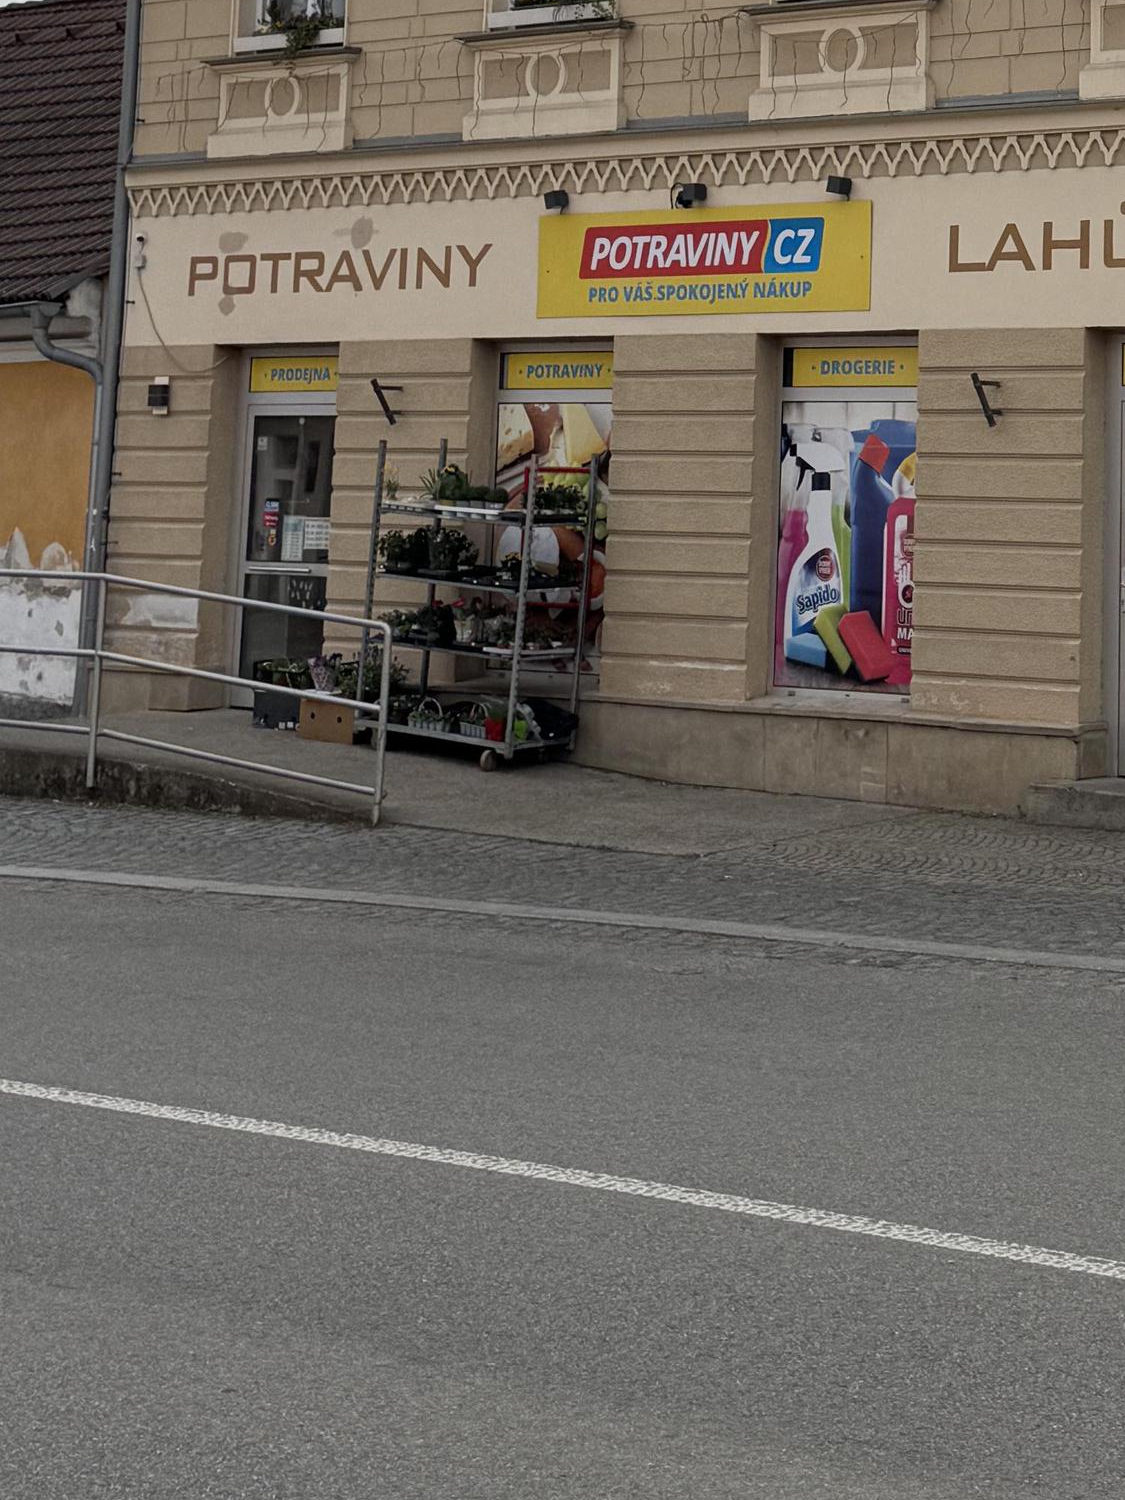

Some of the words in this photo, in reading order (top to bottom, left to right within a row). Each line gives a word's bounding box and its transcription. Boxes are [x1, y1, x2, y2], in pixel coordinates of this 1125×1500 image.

[590, 230, 760, 271] POTRAVINY
[773, 228, 815, 265] CZ
[187, 243, 493, 297] POTRAVINY
[588, 286, 618, 303] PRO
[623, 281, 653, 302] VÁŠ
[656, 277, 749, 304] SPOKOJENÝ
[753, 277, 813, 299] NÁKUP
[270, 366, 331, 384] PRODEJNA
[526, 363, 603, 380] POTRAVINY
[820, 358, 896, 376] DROGERIE
